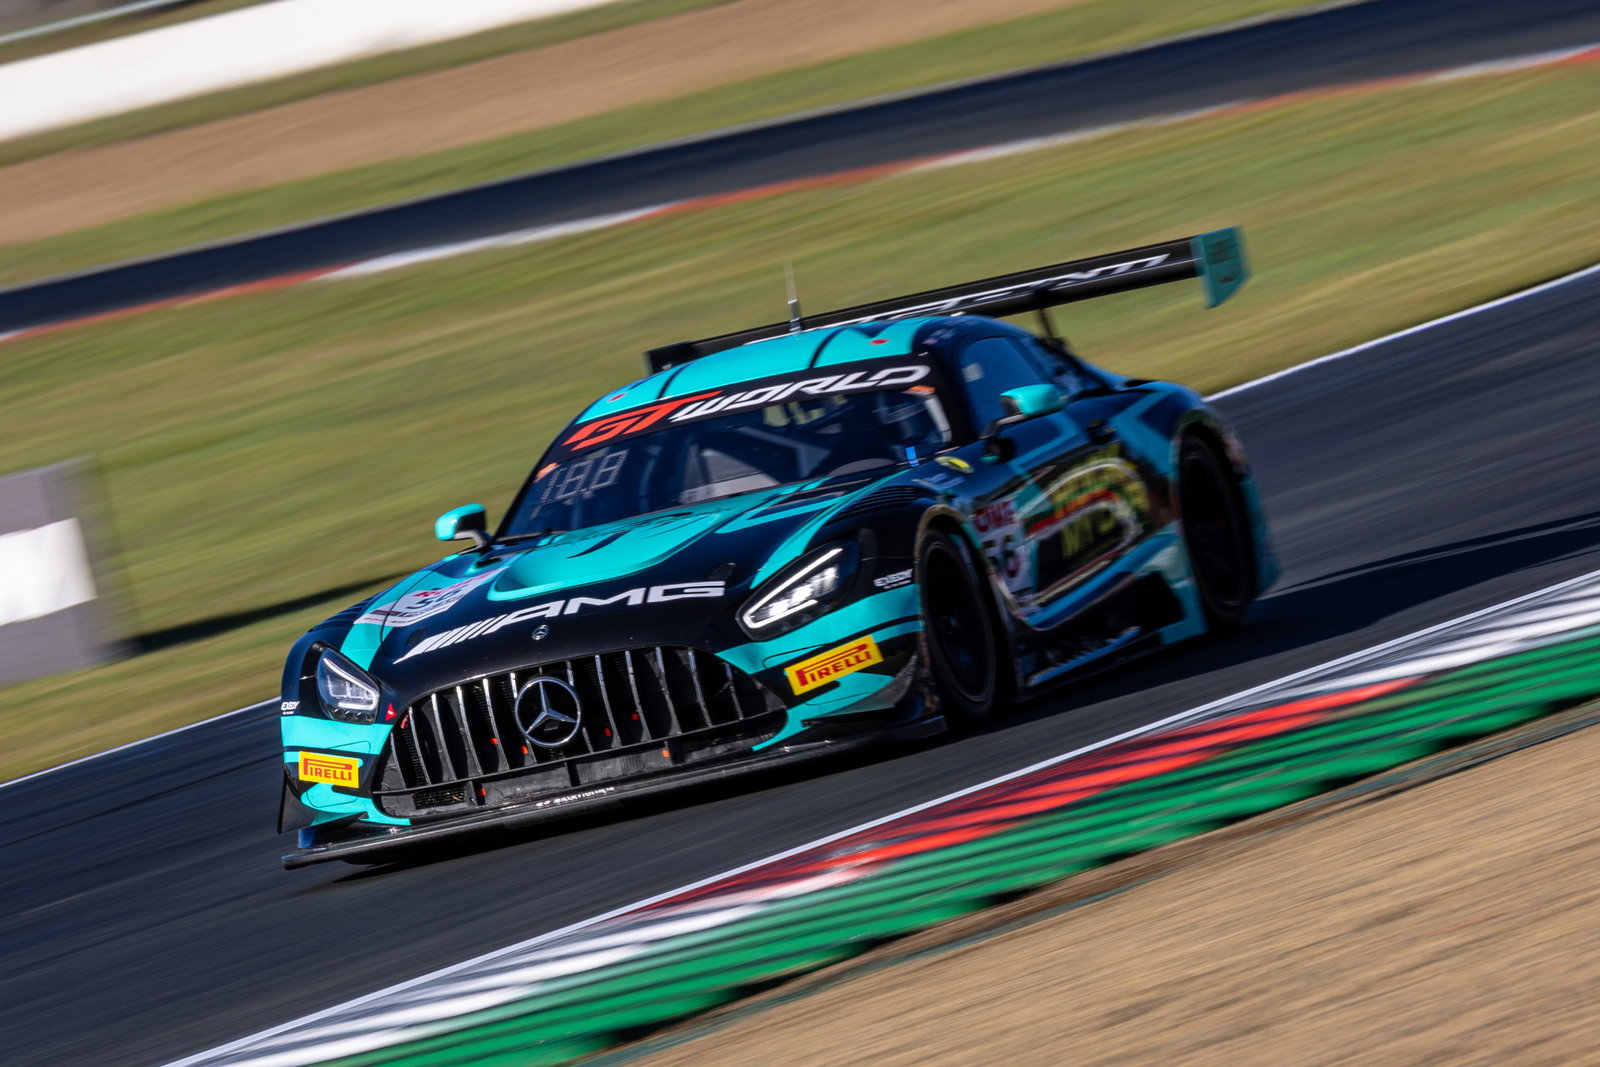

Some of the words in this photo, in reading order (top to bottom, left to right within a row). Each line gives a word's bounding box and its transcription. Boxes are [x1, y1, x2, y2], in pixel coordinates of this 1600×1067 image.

[562, 390, 724, 452] GT
[669, 365, 931, 423] WORLD
[794, 642, 873, 687] PIRELLI
[303, 756, 353, 782] PIRELLI
